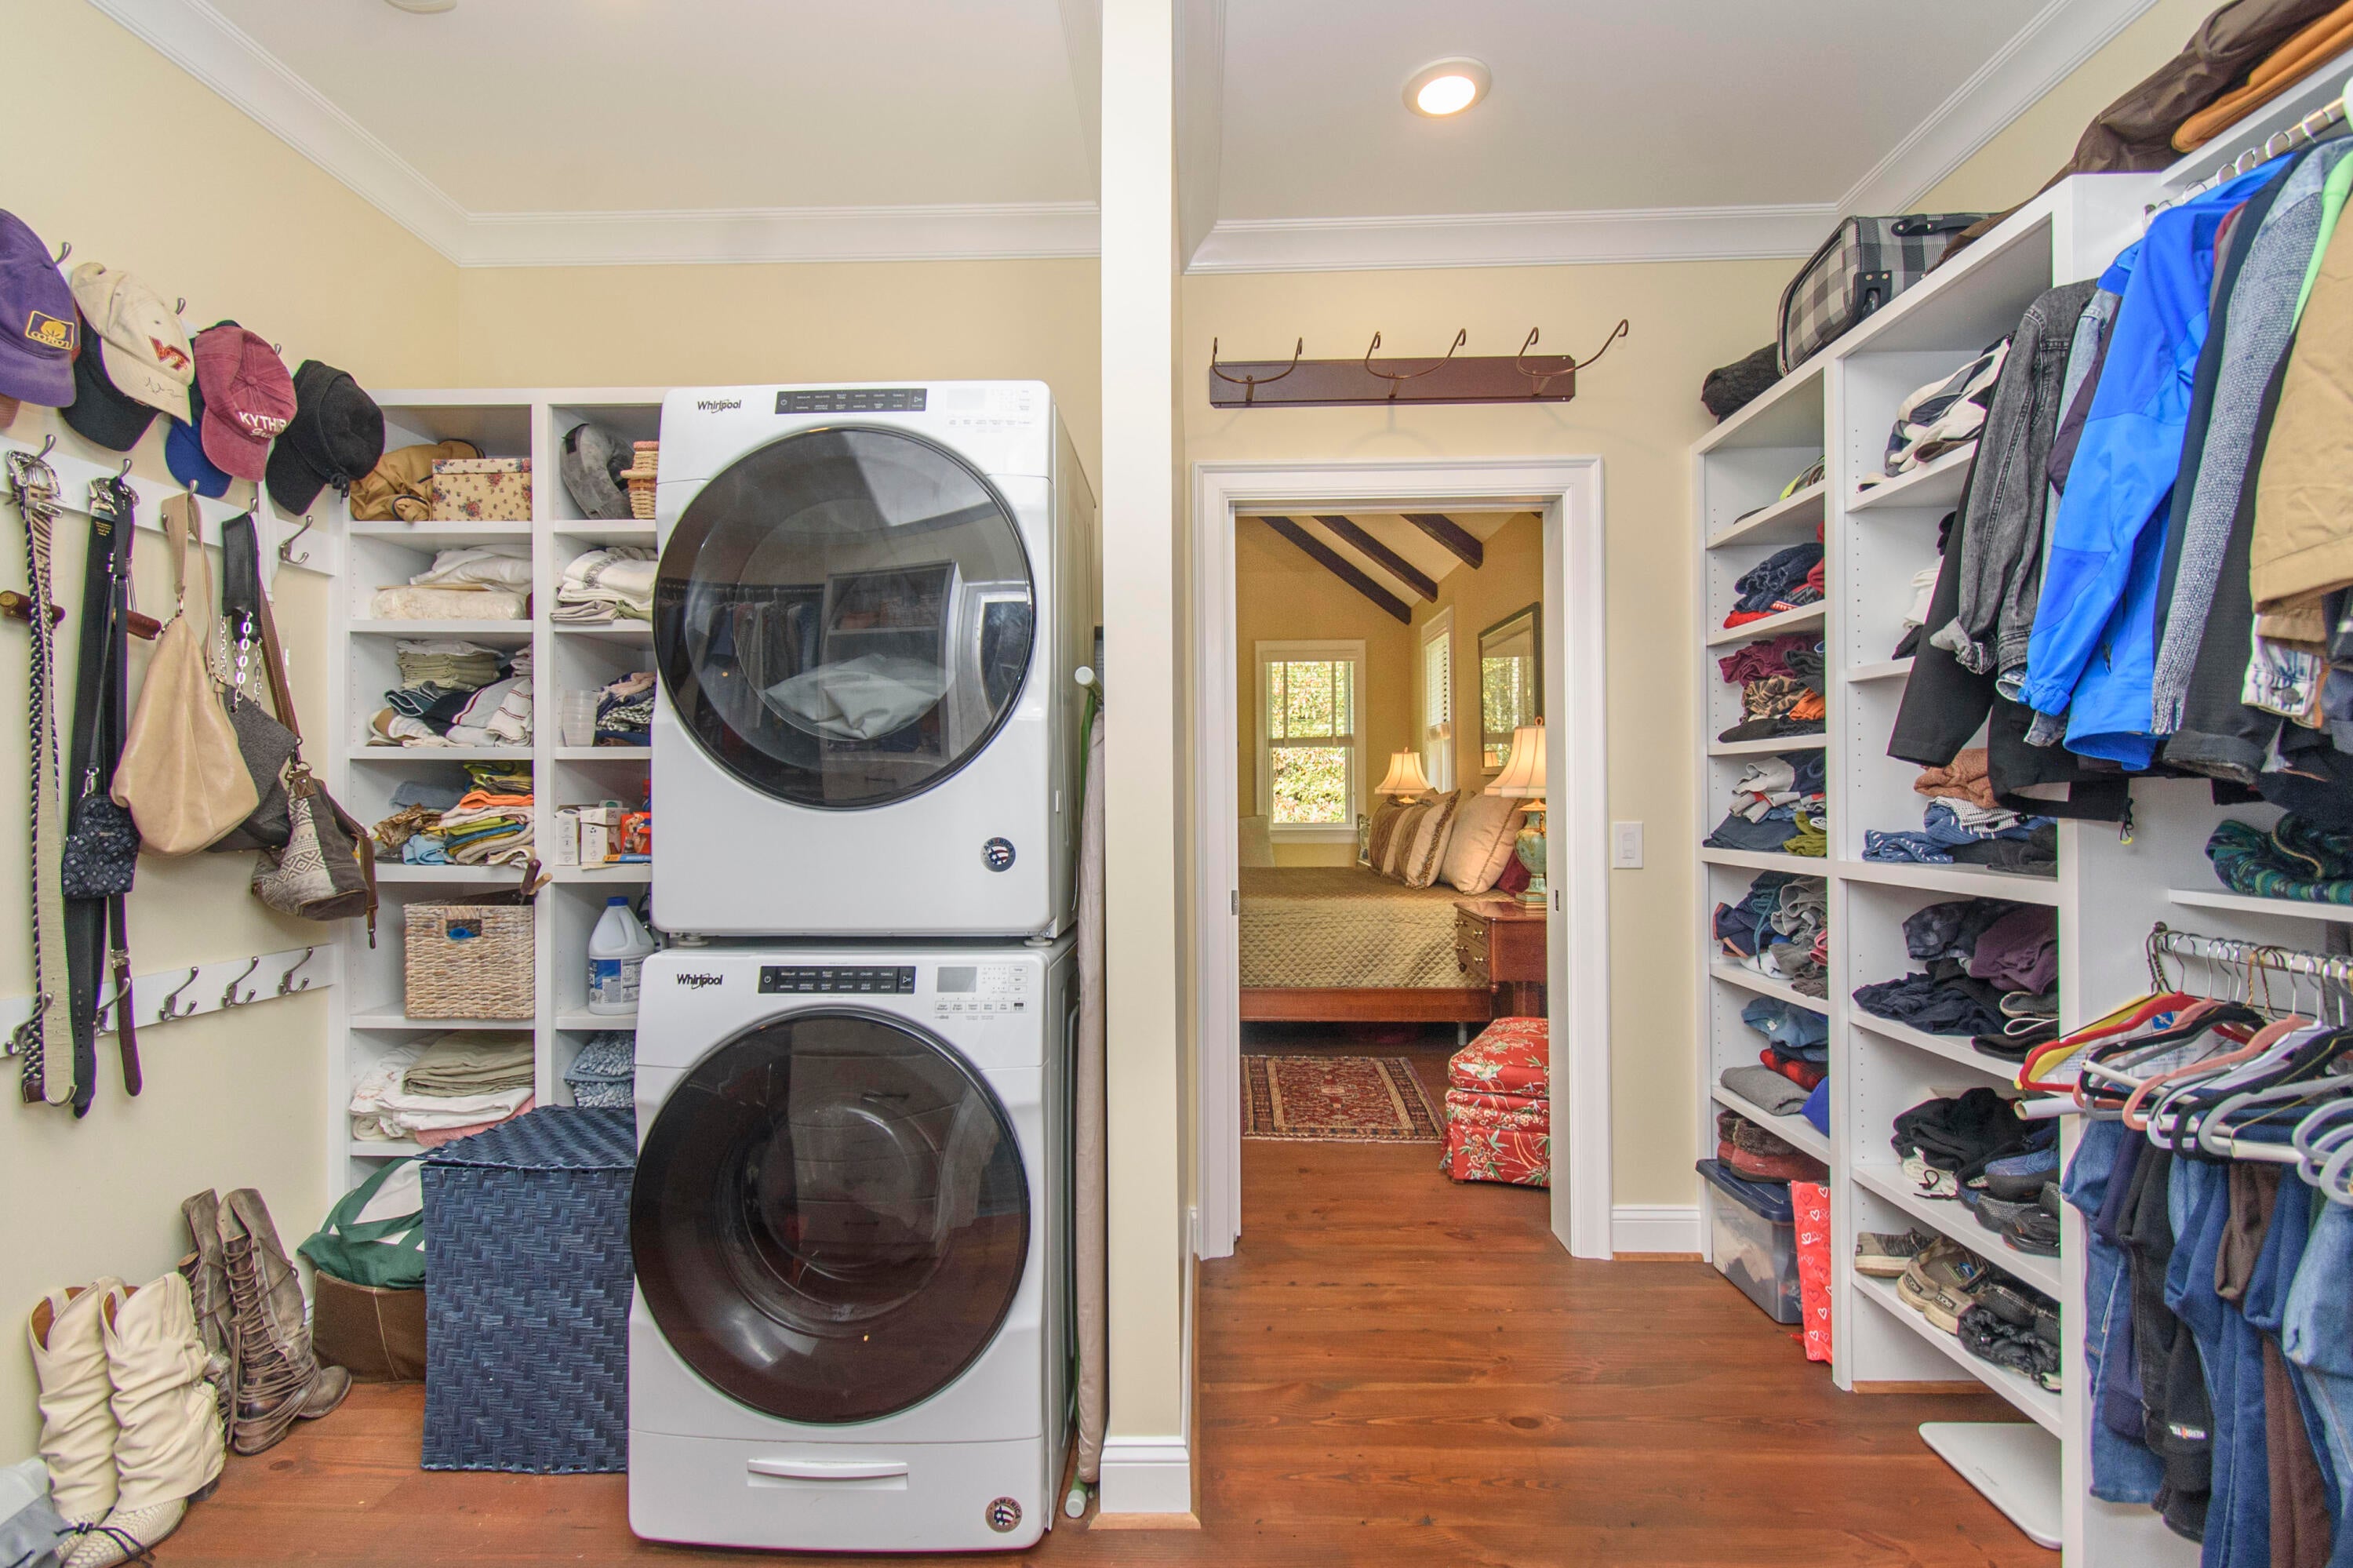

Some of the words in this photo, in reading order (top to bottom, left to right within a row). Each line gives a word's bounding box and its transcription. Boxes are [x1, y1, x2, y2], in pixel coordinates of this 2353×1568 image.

[697, 398, 742, 413] Whirlpool
[677, 973, 724, 989] Whirlpool
[994, 1498, 1021, 1519] AMERICA
